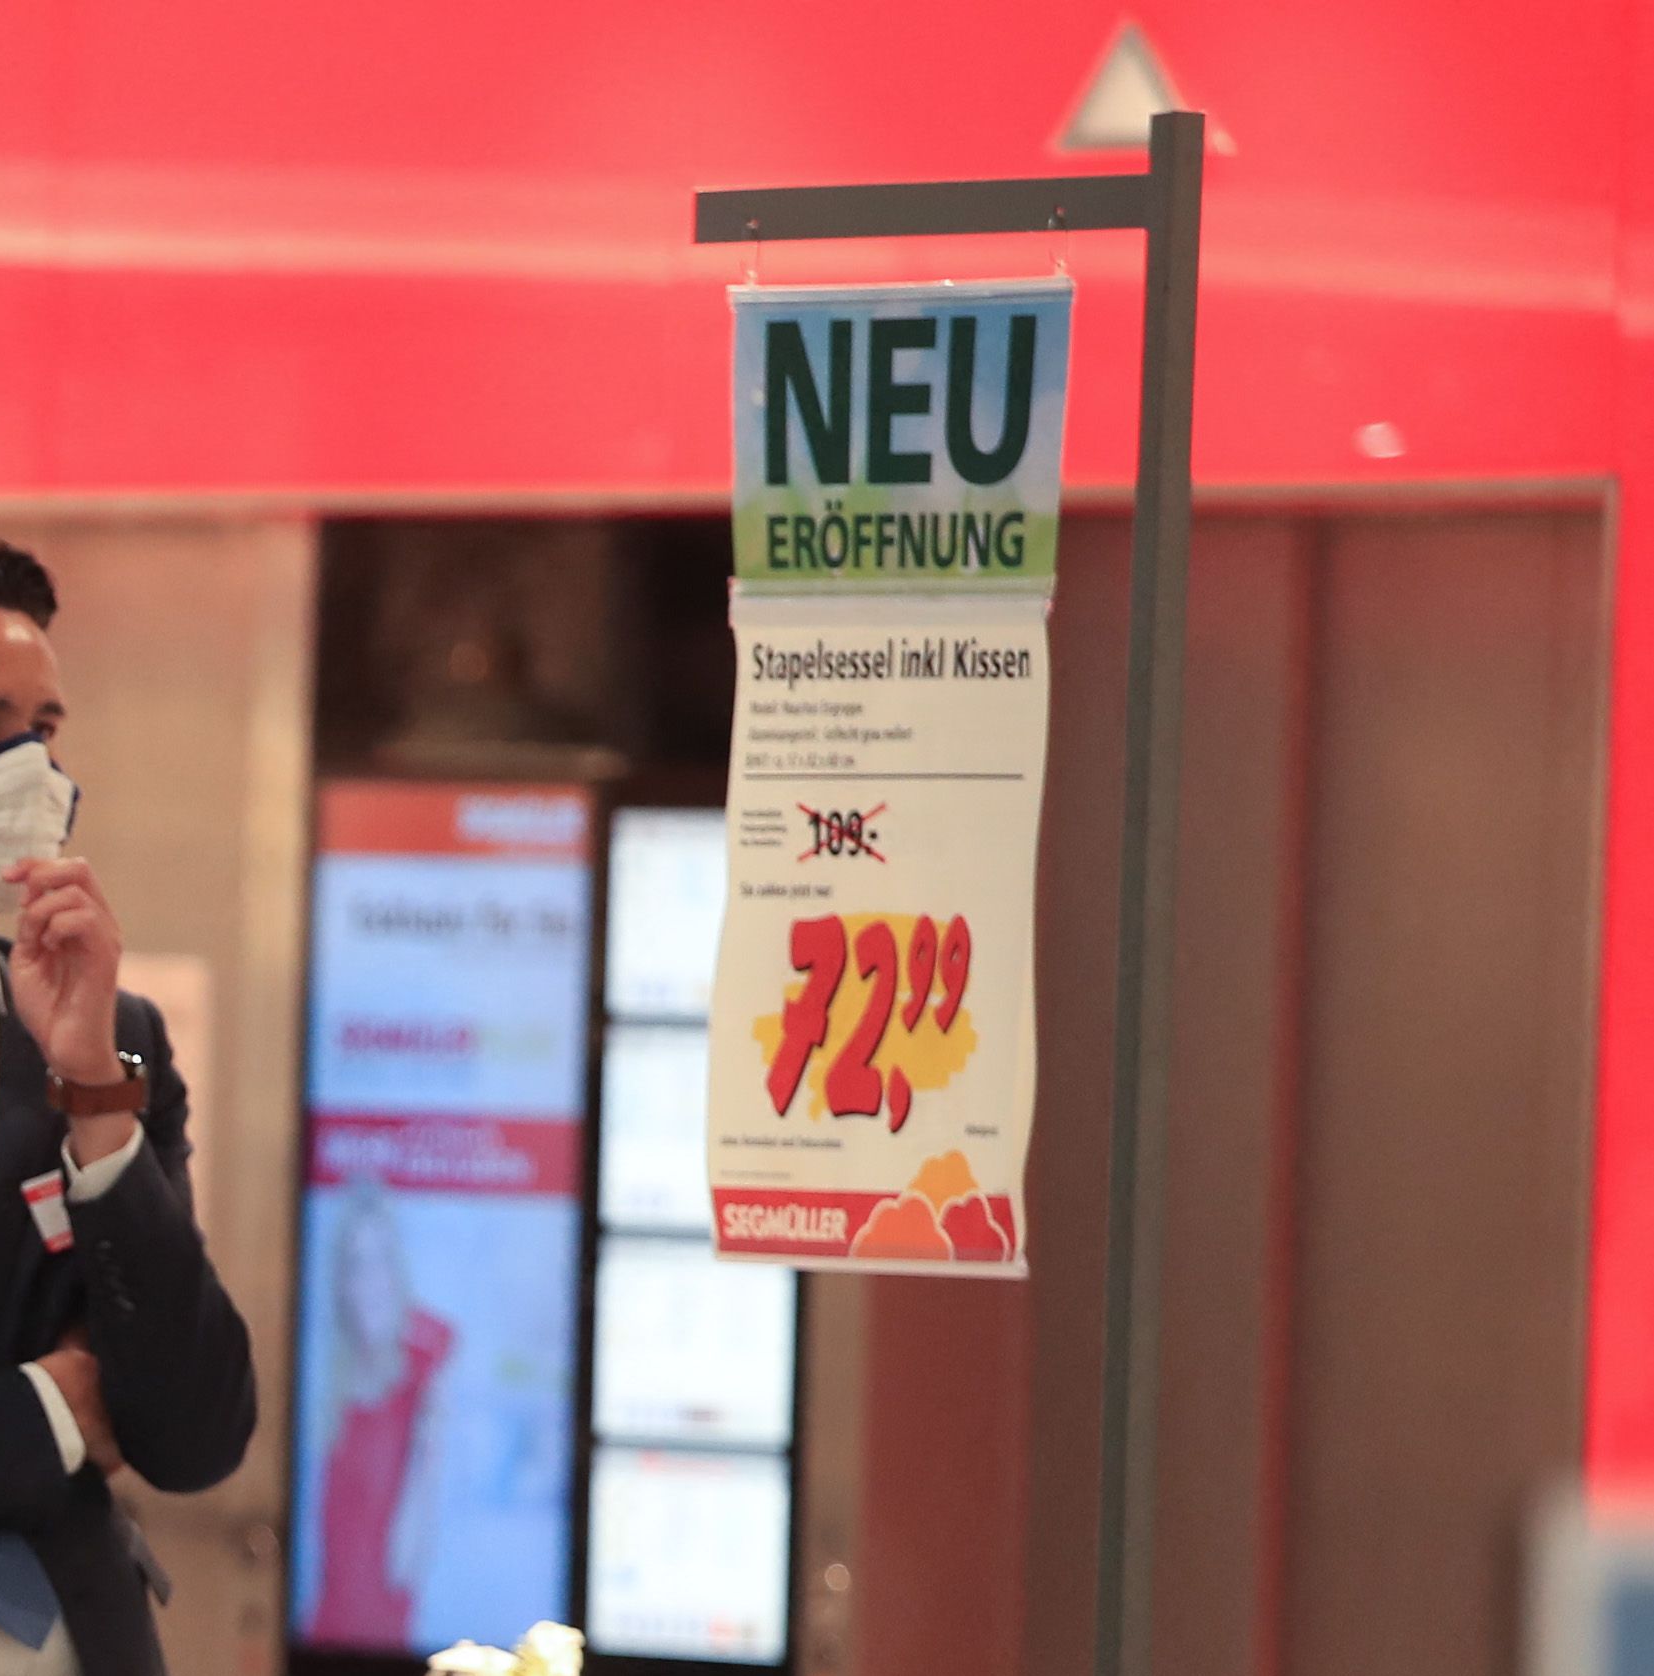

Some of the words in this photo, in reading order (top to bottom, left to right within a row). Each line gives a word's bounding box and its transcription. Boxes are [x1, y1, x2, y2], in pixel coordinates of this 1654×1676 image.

[766, 315, 1037, 485] NEU
[767, 499, 1026, 571] ERÖFFNUNG
[753, 638, 893, 690] Stapelsessel
[900, 637, 946, 679] inkl
[953, 636, 1031, 679] Kissen
[723, 1202, 849, 1243] SEGMÜLLER
